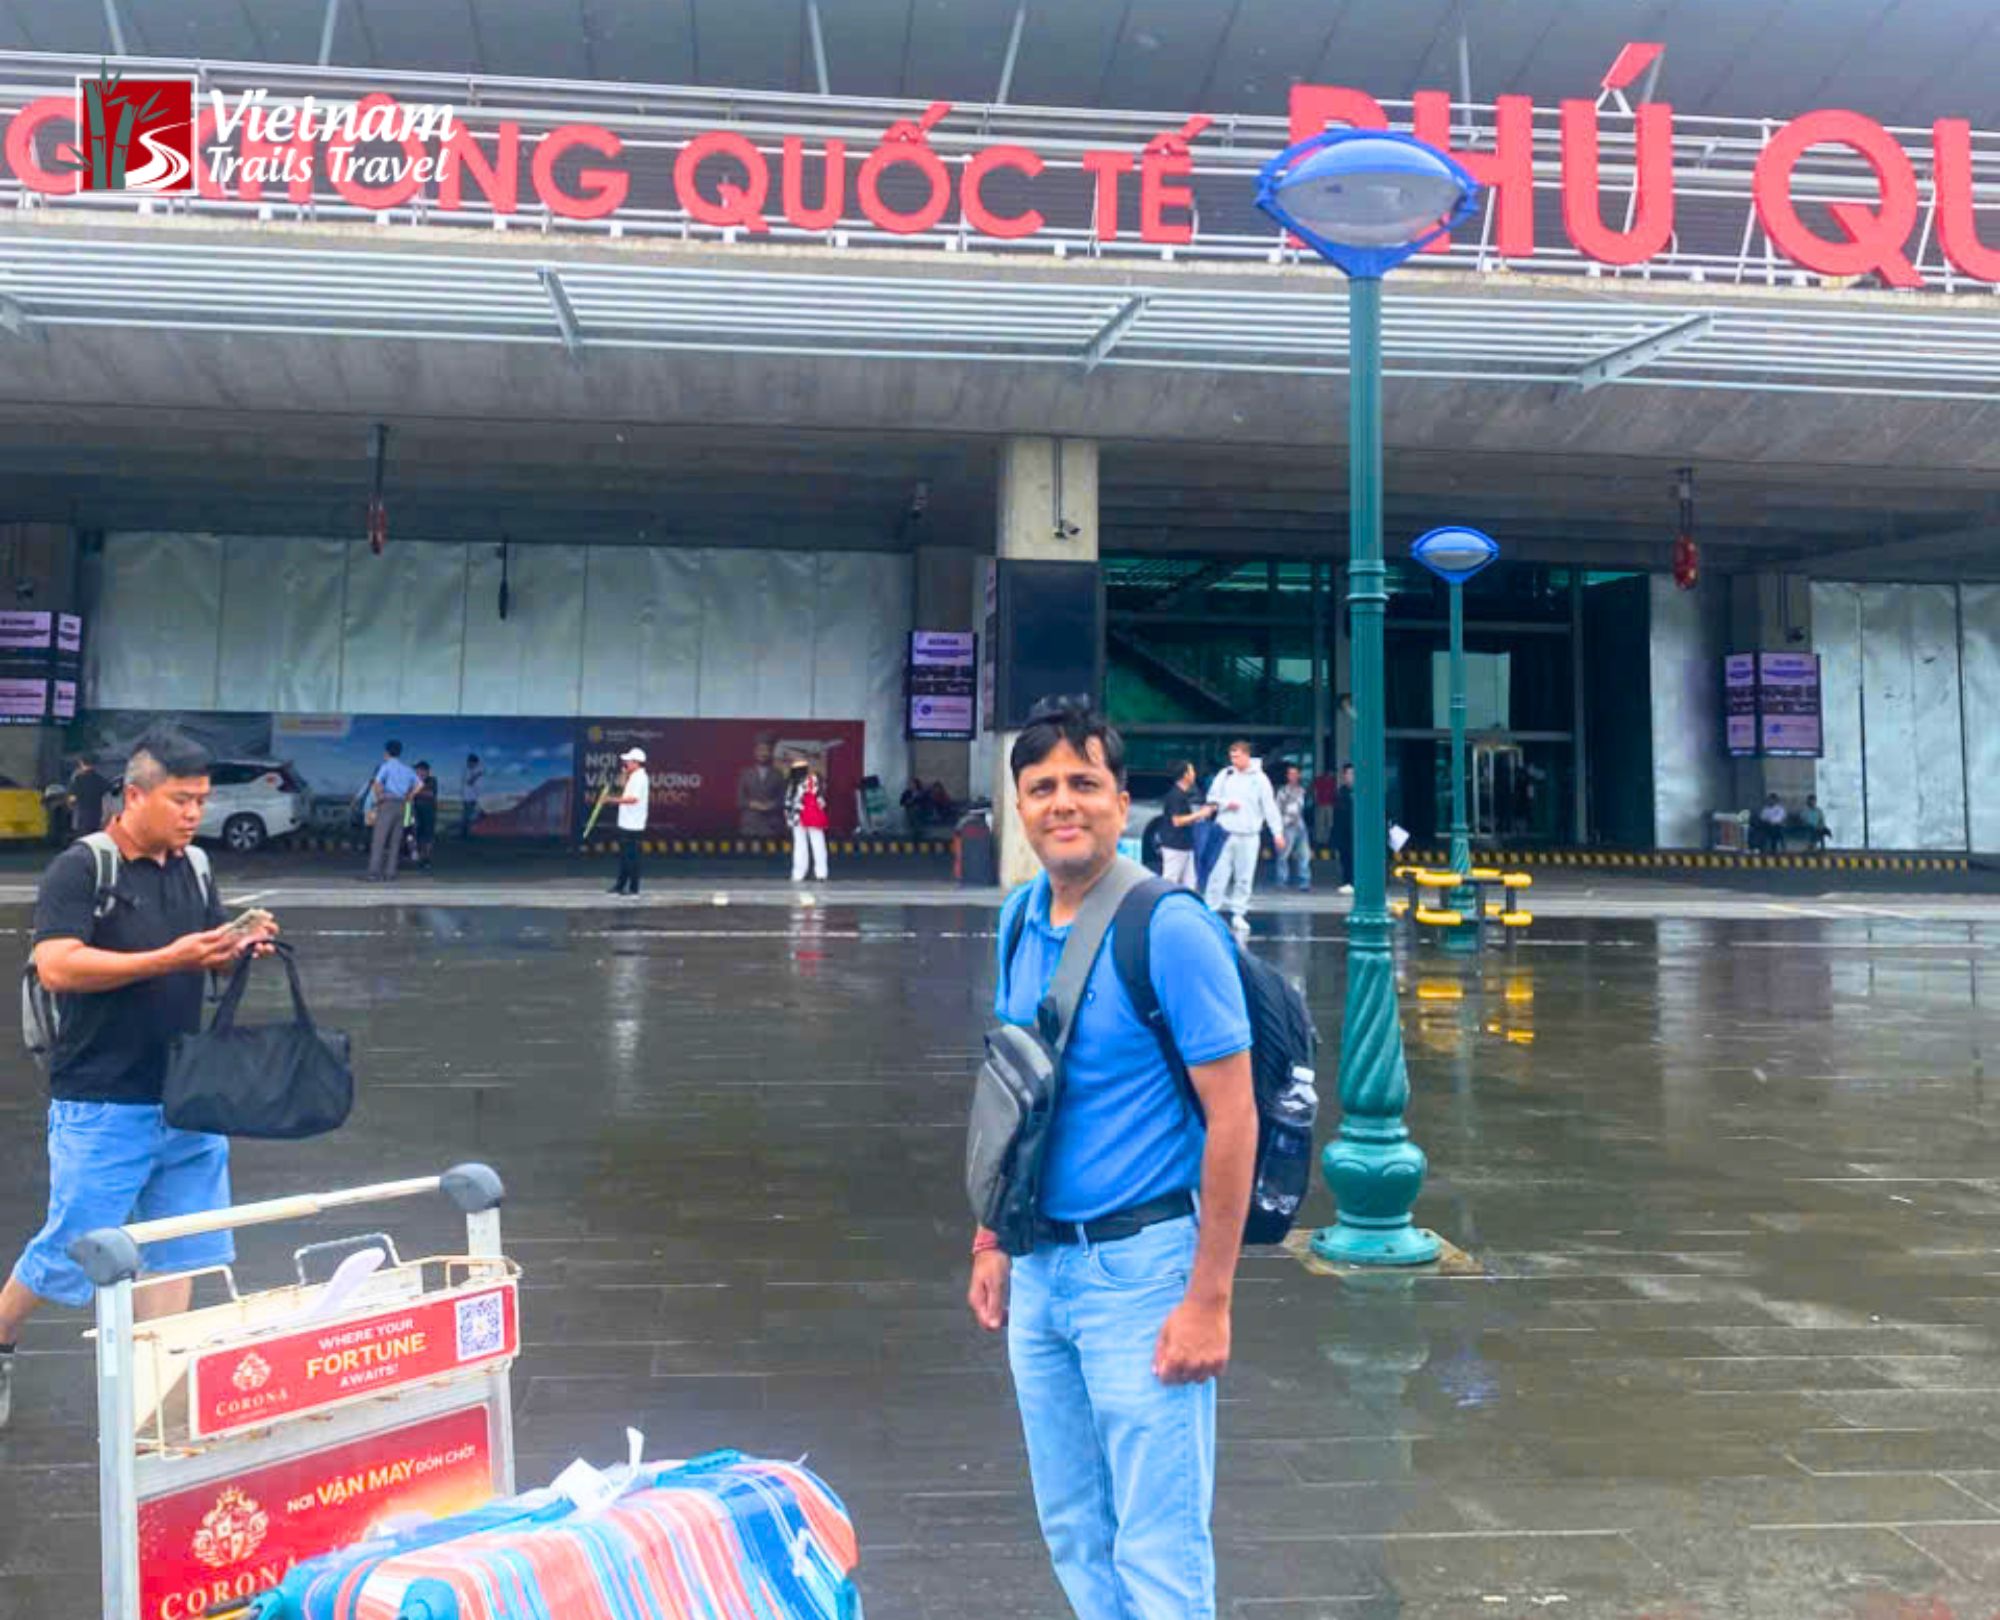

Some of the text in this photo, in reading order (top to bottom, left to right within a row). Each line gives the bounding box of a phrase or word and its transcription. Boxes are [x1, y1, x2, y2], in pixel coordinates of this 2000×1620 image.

[674, 101, 1044, 239] QUỐC
[1082, 114, 1212, 244] TẾ
[306, 1332, 427, 1380] FORTUNE
[318, 1318, 414, 1351] WHERE YOUR
[215, 1386, 289, 1417] CORONA
[316, 1473, 364, 1505] VẬN
[367, 1459, 415, 1490] MAY
